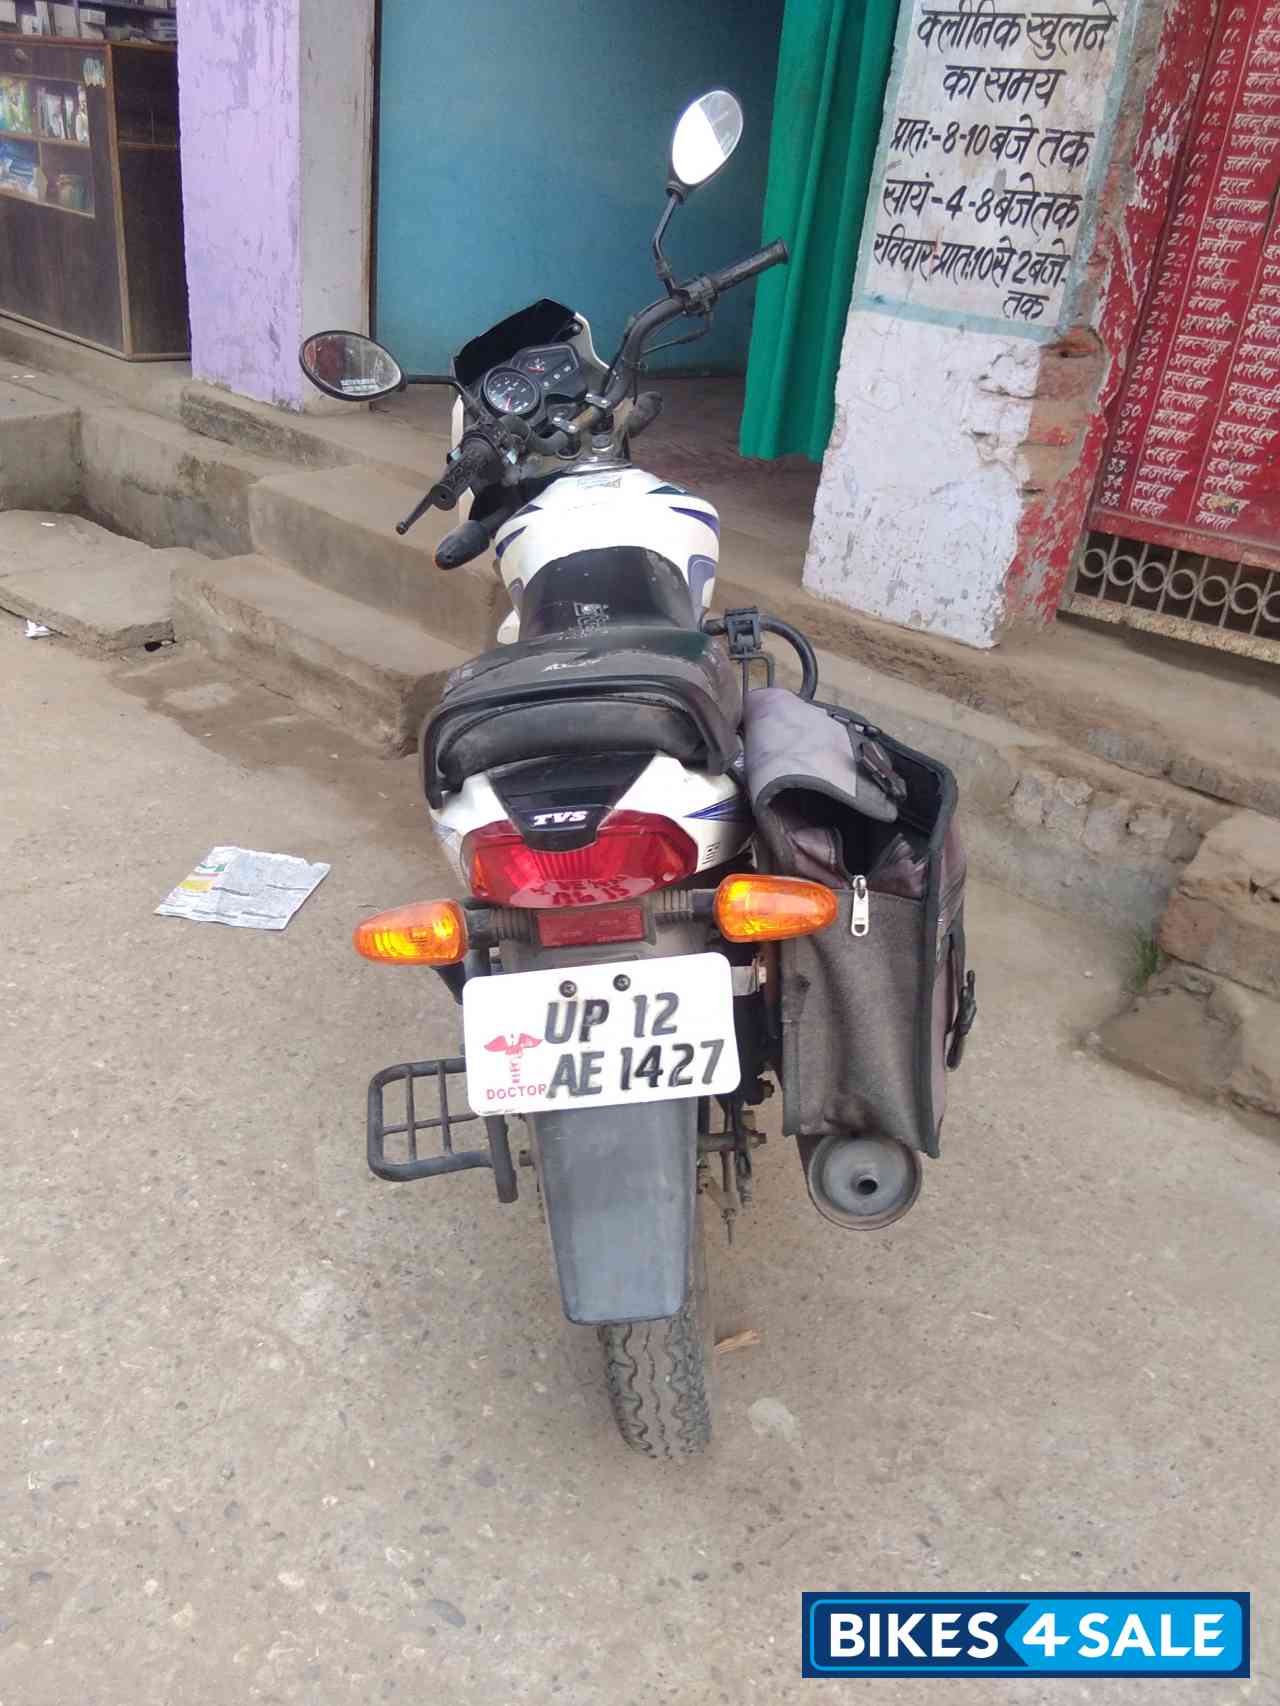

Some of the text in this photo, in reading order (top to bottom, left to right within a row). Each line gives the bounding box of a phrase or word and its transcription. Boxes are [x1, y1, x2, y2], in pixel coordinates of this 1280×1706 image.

[917, 0, 1119, 60] क्लीनिक खुलने
[943, 64, 1067, 109] का समय
[1037, 127, 1095, 173] तक
[1031, 192, 1084, 236] तक
[1012, 249, 1032, 284] 2
[1003, 290, 1050, 321] तक
[533, 810, 588, 826] TVS
[544, 992, 680, 1044] UP 12
[545, 1038, 725, 1099] AE 1427
[486, 1083, 547, 1100] DOCTOR
